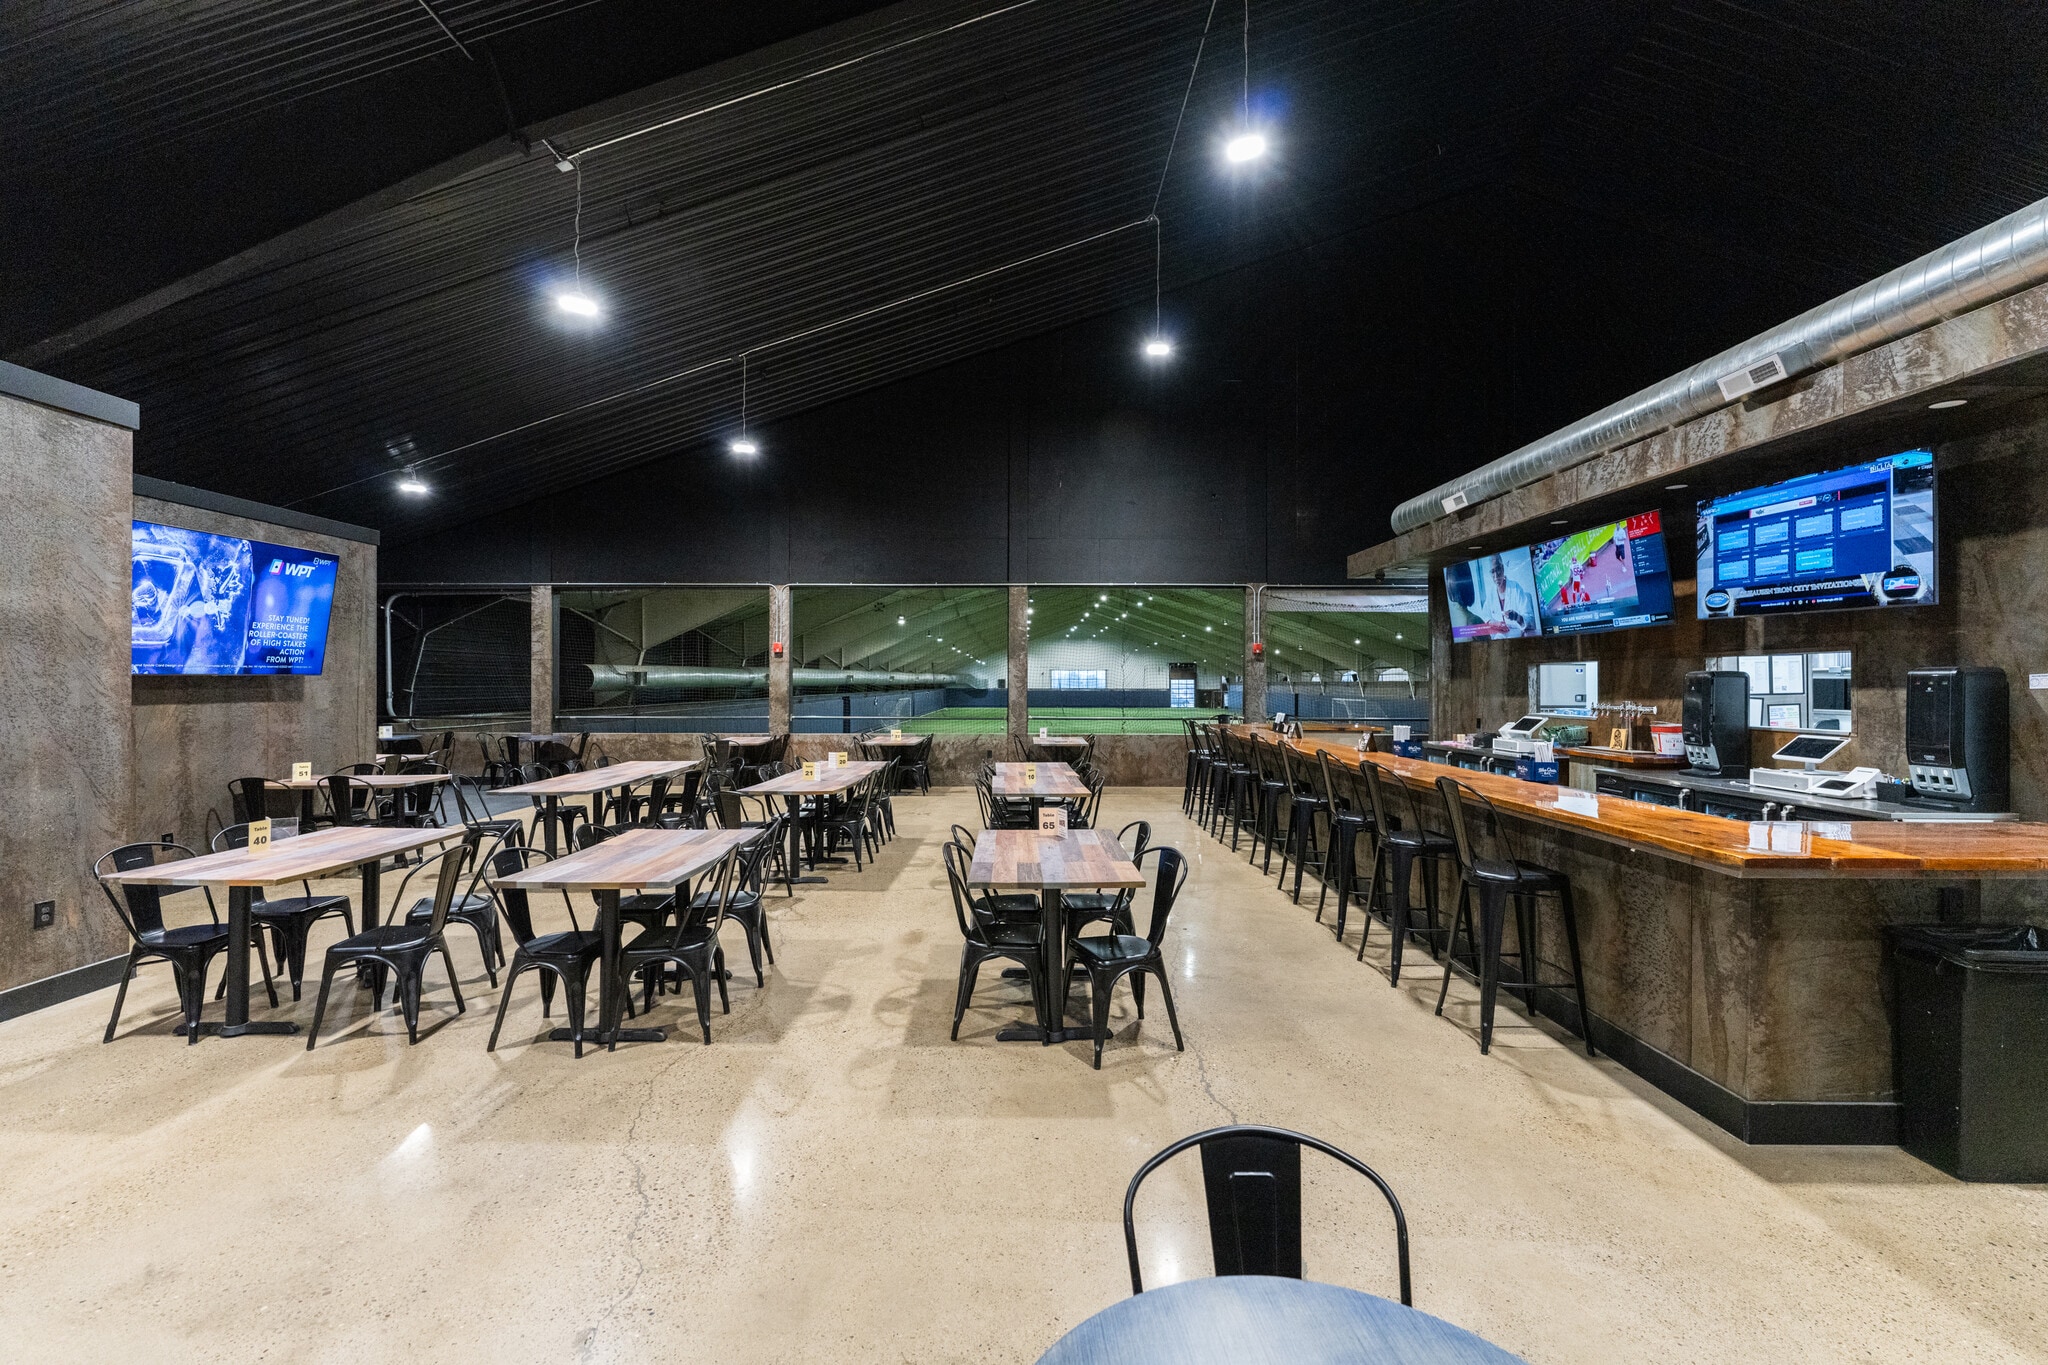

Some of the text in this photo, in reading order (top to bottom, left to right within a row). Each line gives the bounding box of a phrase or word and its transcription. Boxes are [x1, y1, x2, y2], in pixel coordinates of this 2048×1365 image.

[285, 562, 316, 578] WPT
[1541, 563, 1562, 591] NATIONAL
[1561, 541, 1587, 567] FOOTBALL
[1792, 584, 1810, 593] CITY
[286, 616, 310, 624] TUNED!
[252, 622, 294, 631] EXPERIENCE
[248, 630, 308, 640] ROLLER-COASTER
[283, 640, 307, 648] STAKES
[1042, 821, 1055, 830] 65
[253, 835, 267, 846] 40
